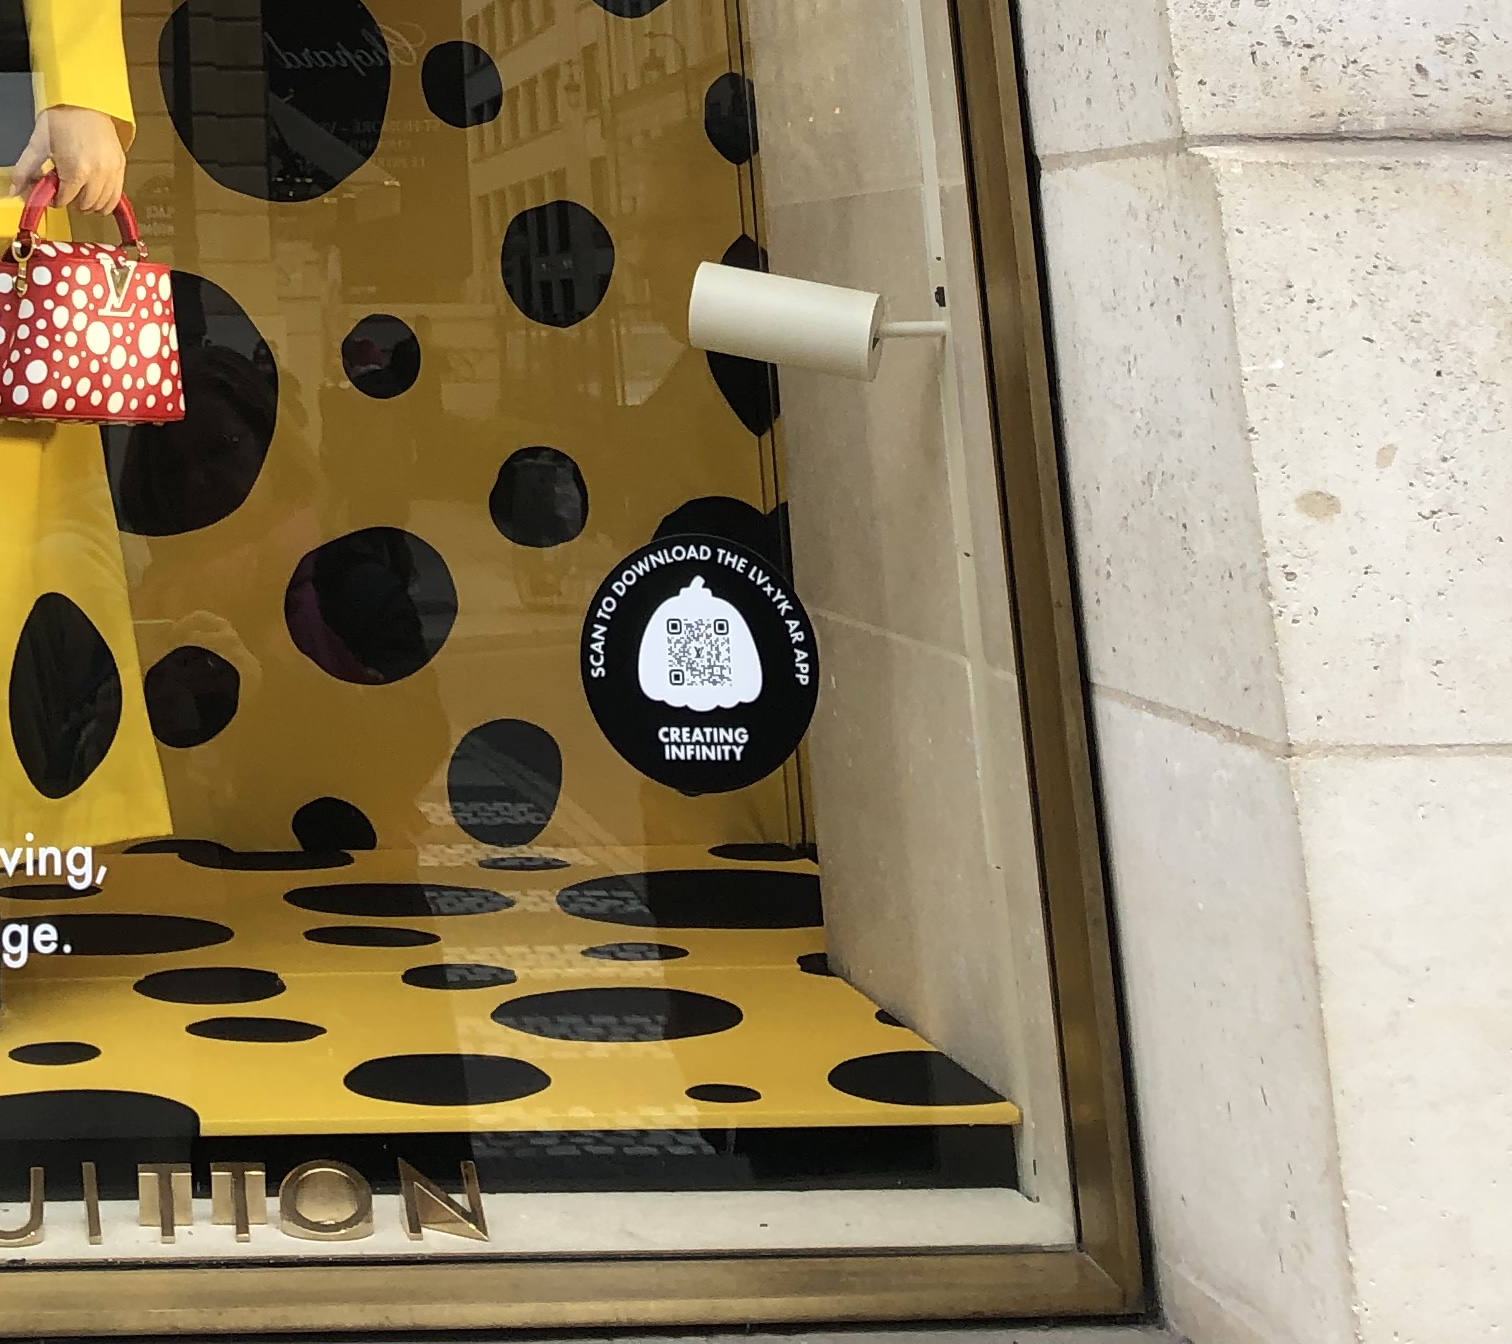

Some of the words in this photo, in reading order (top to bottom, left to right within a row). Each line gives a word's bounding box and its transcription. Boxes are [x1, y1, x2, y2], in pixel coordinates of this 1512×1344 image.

[611, 544, 712, 597] DOWNLOAD
[716, 548, 748, 573] THE
[747, 565, 794, 617] LVxYK
[596, 596, 617, 620] TO
[784, 619, 805, 644] AR
[590, 623, 607, 678] SCAN
[793, 648, 809, 686] APP
[658, 726, 750, 744] CREATING
[664, 744, 745, 761] INFINITY
